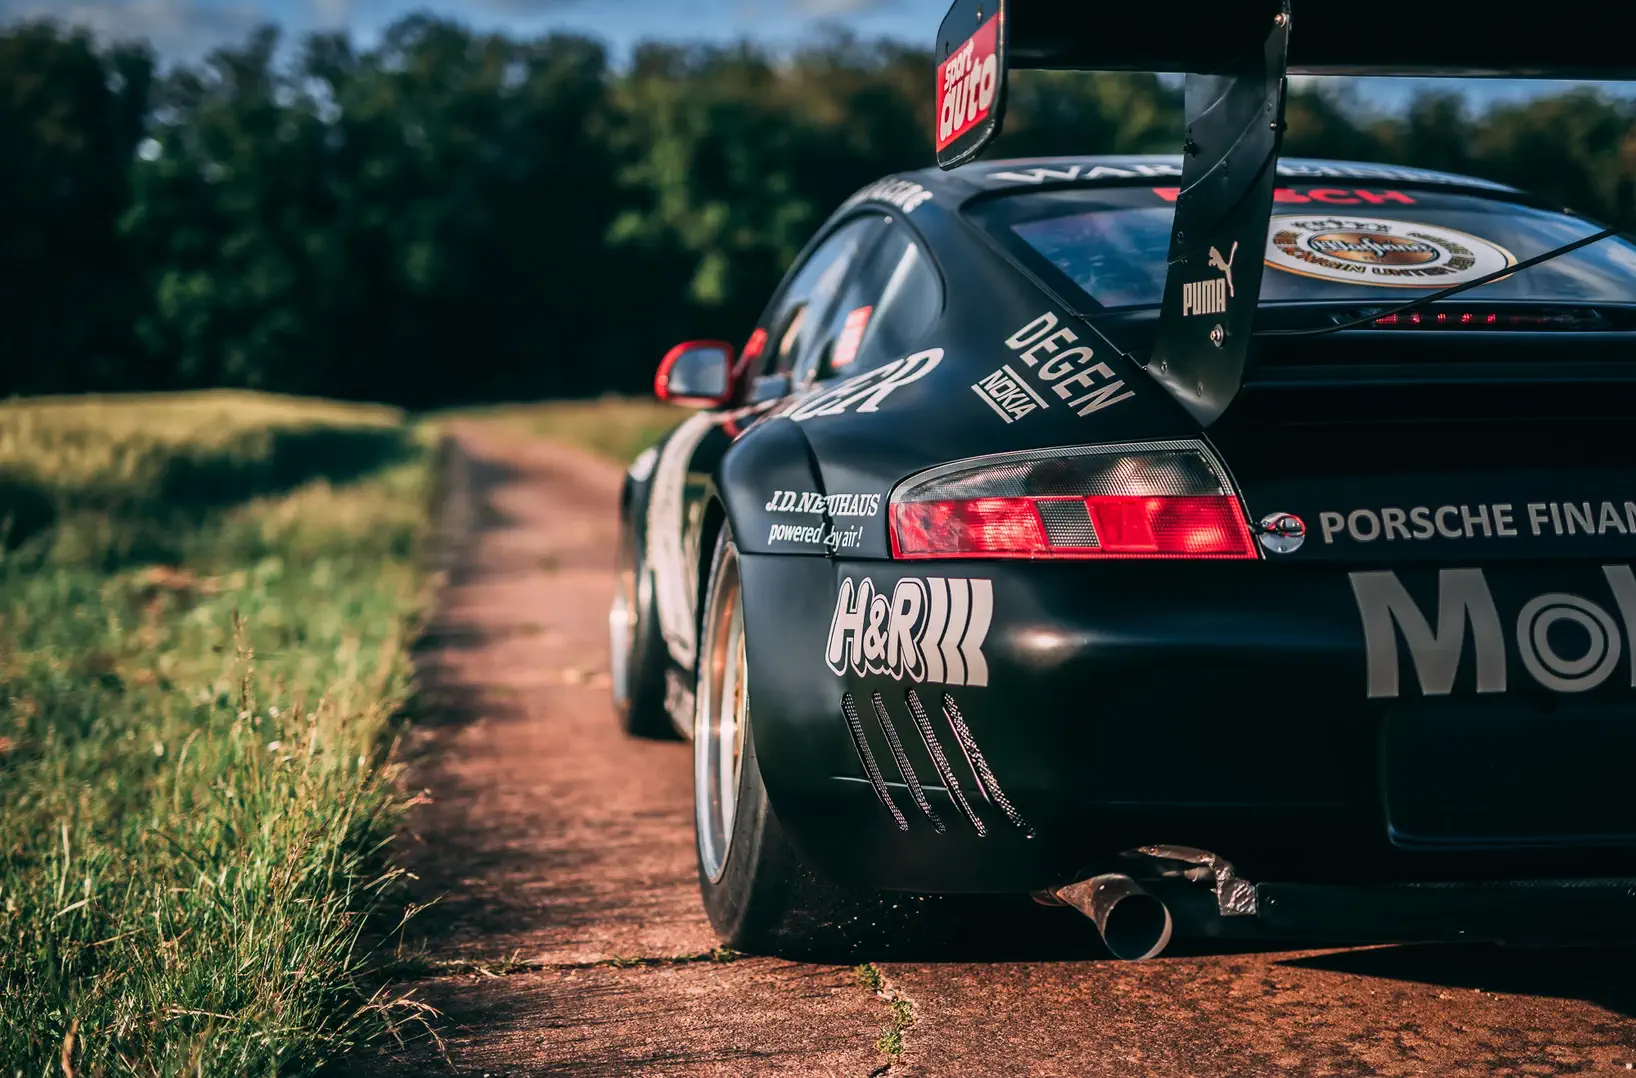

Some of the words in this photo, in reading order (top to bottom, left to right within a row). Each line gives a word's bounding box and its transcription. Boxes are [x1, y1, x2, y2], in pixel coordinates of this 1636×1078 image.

[944, 38, 975, 92] sport
[940, 53, 997, 142] auto
[1183, 278, 1226, 316] PUMA
[1005, 311, 1136, 417] DEGEN
[978, 368, 1037, 421] NOKIA
[767, 522, 826, 545] powered
[841, 525, 863, 548] air!
[1320, 503, 1518, 544] PORSCHE
[825, 577, 927, 683] H&R
